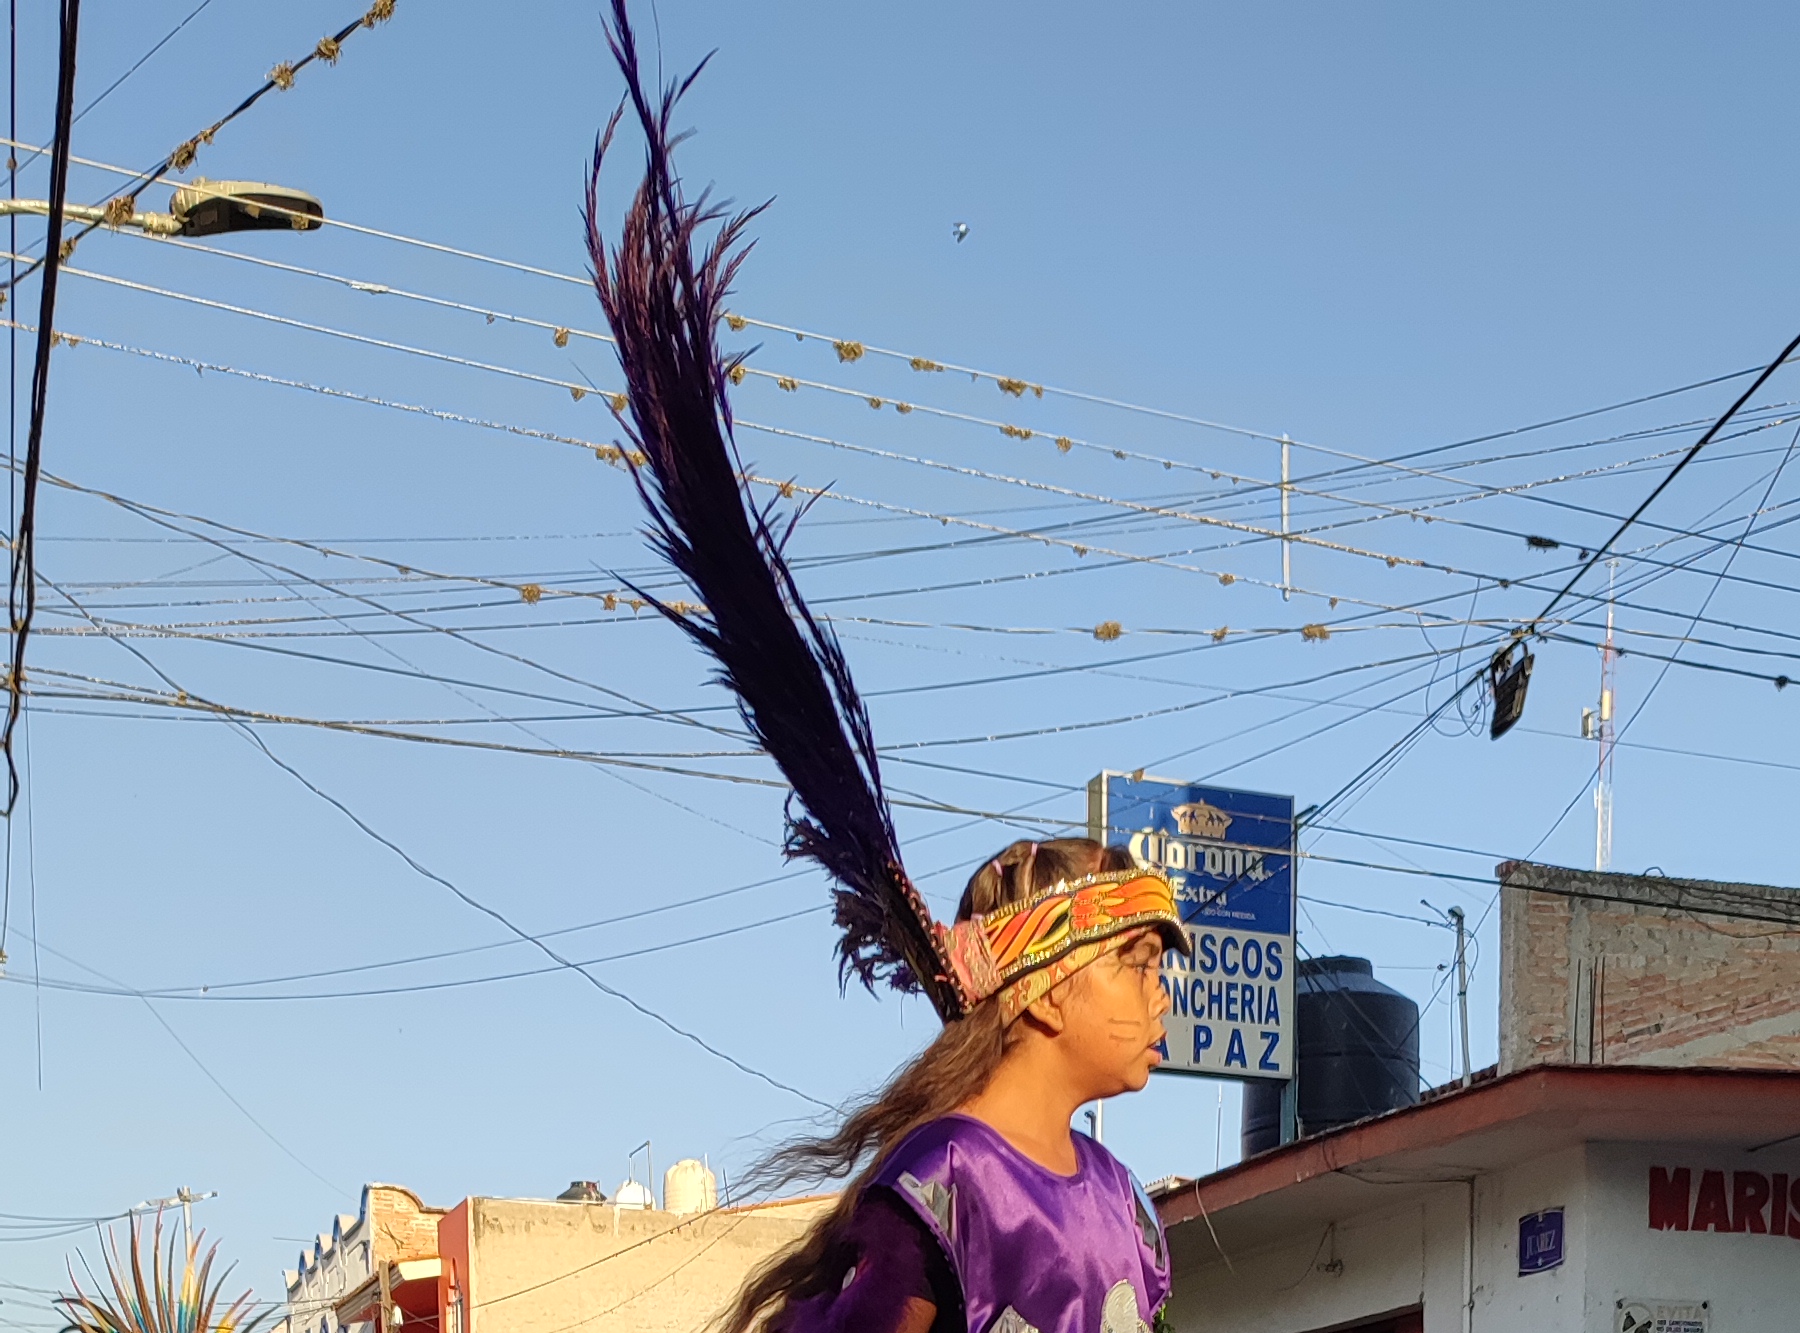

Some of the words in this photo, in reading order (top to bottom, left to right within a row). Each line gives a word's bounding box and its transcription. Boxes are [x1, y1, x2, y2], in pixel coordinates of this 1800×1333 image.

[1129, 827, 1269, 882] Corona
[1173, 876, 1227, 906] Extra
[1160, 932, 1283, 982] ISCOS
[1193, 1024, 1280, 1072] PAZ
